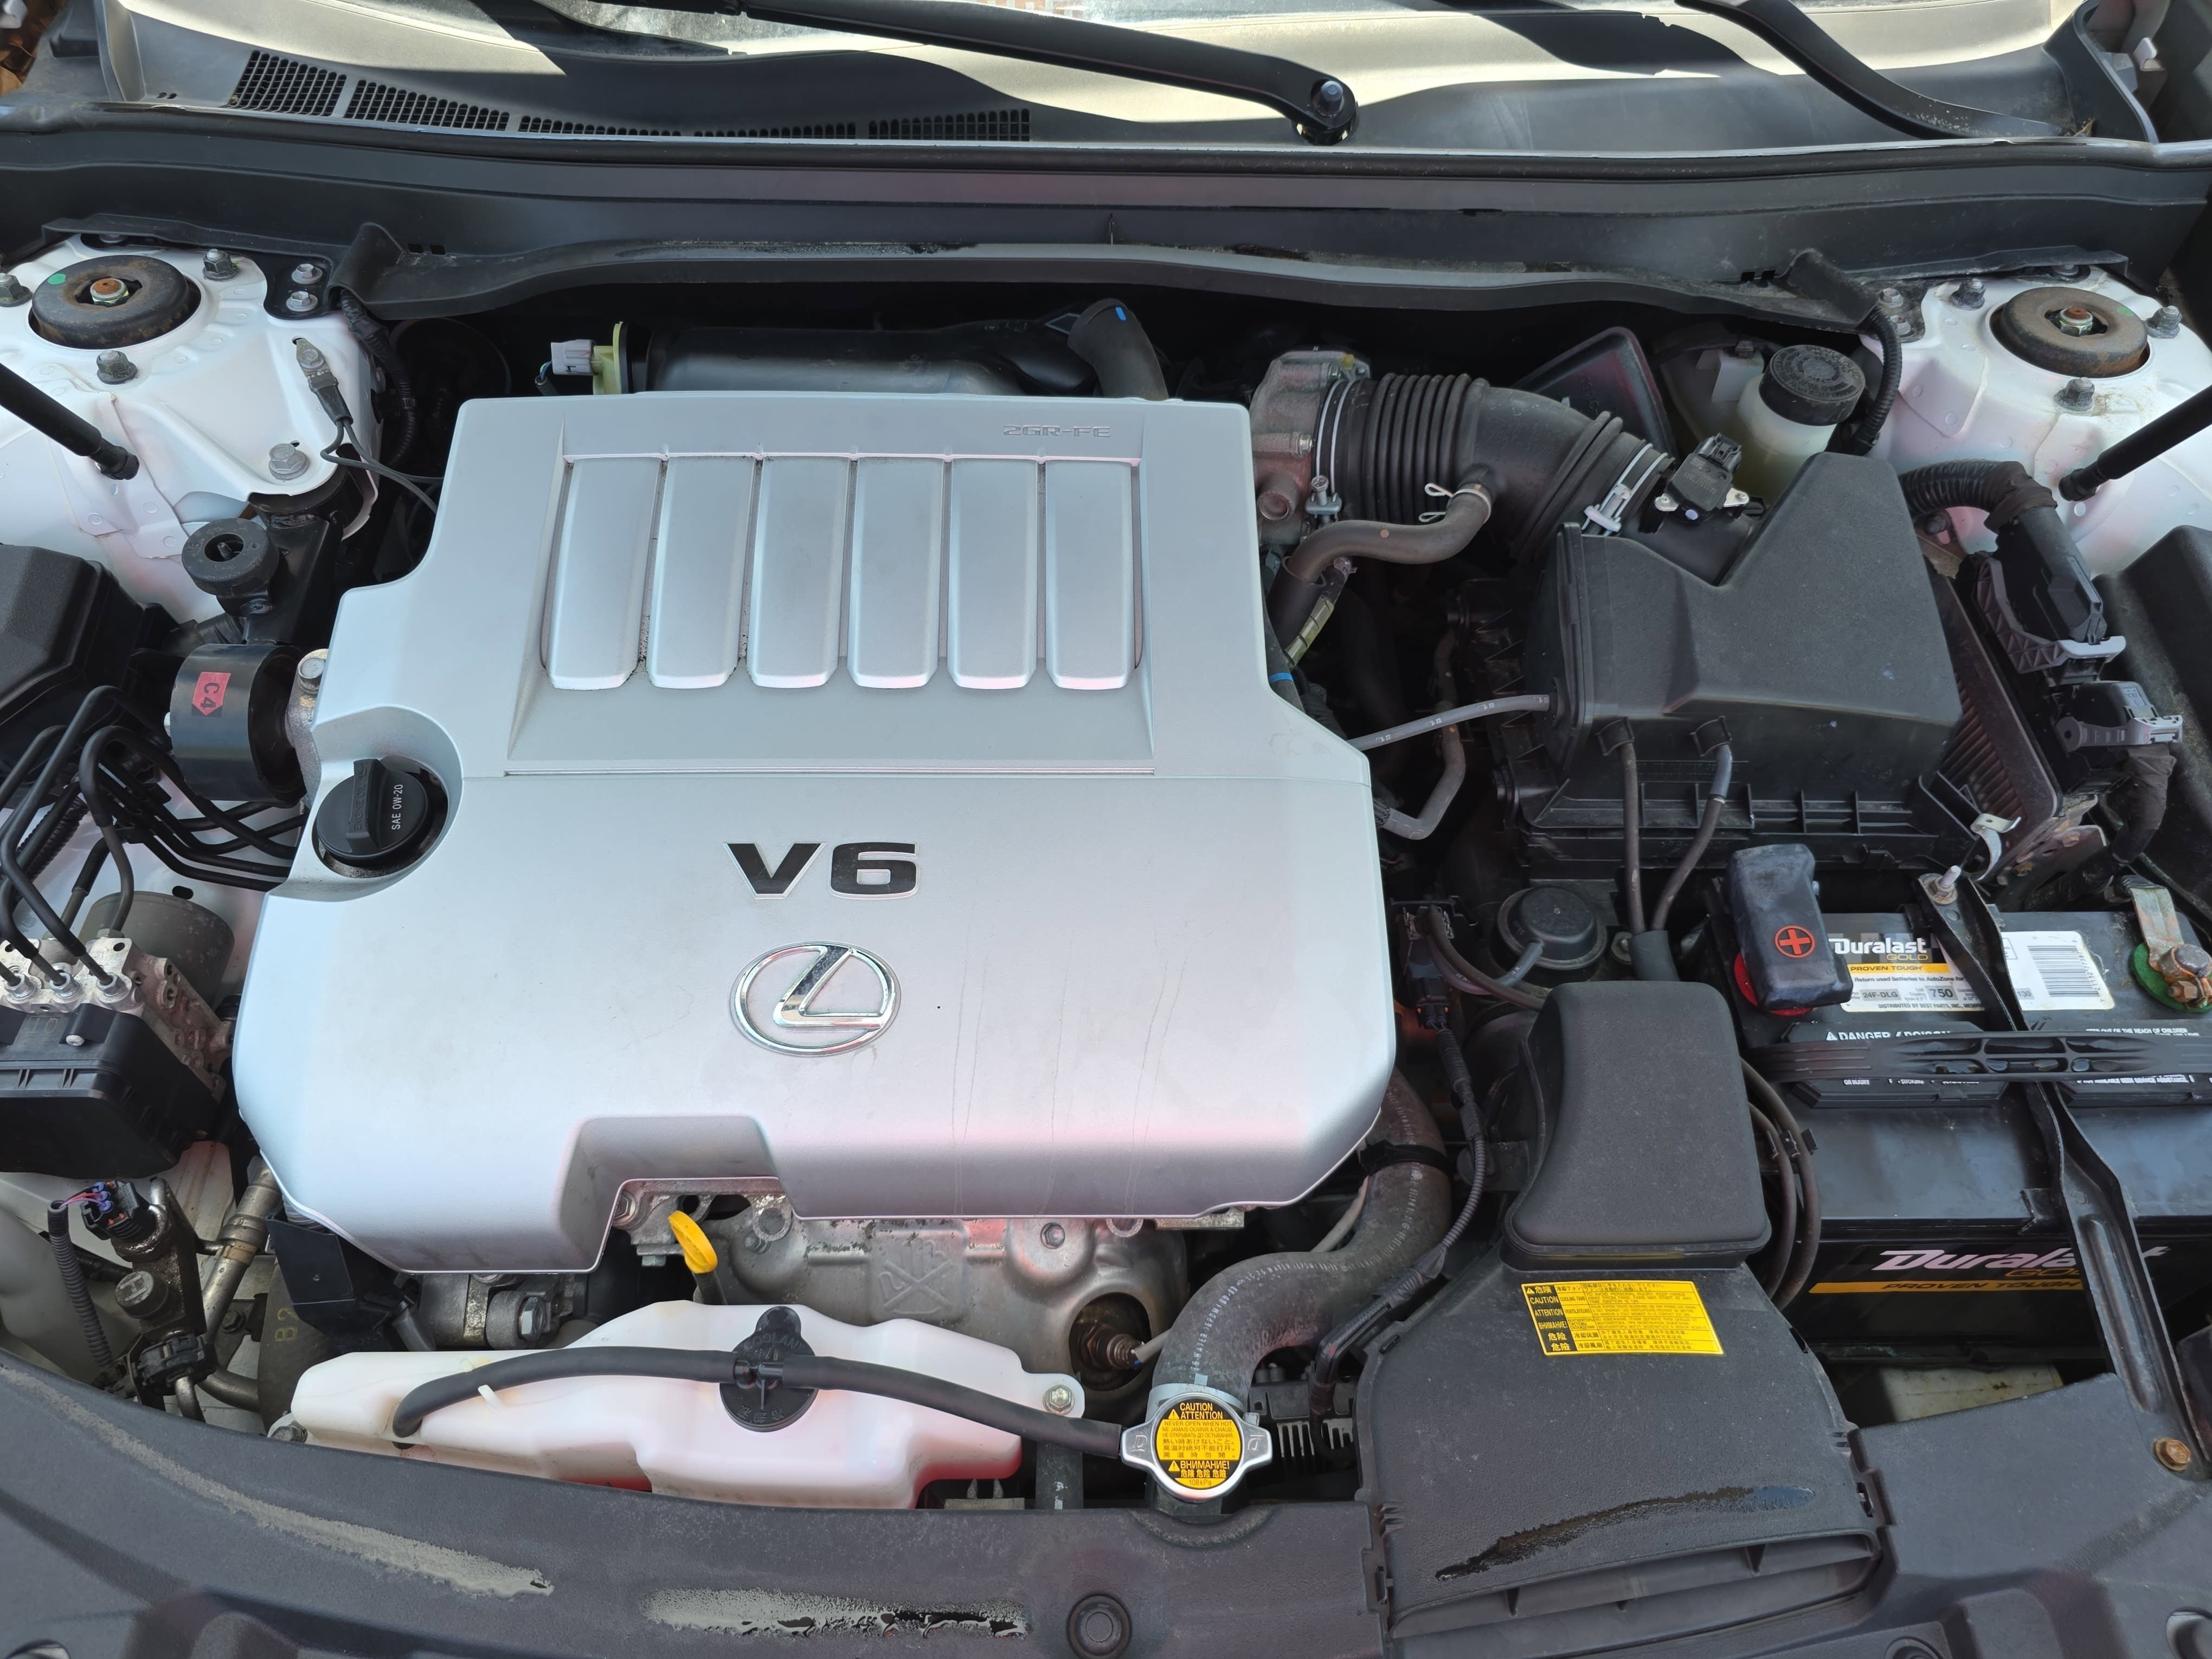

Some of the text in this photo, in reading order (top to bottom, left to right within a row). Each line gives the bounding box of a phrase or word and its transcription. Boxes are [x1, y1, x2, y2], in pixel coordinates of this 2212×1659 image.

[1003, 425, 1111, 438] 2GR-FE
[353, 784, 367, 831] ENGINE OIL
[391, 783, 403, 831] SAE 0W-20
[723, 841, 918, 899] V6
[1828, 937, 1927, 955] Duralast
[1928, 988, 1953, 998] 750
[2016, 989, 2033, 998] 130
[1535, 1285, 1552, 1294] 危険
[1529, 1296, 1559, 1304] CAUTION
[1534, 1308, 1564, 1317] ATTENTION
[1538, 1321, 1568, 1329] ВНИМАНИЕ!
[1547, 1332, 1567, 1341] 危险
[1551, 1342, 1571, 1351] 危險
[1180, 1402, 1213, 1411] CAUTION
[1180, 1411, 1223, 1419] ATTENTION
[1180, 1461, 1230, 1469] ВНИМАНИЕ!
